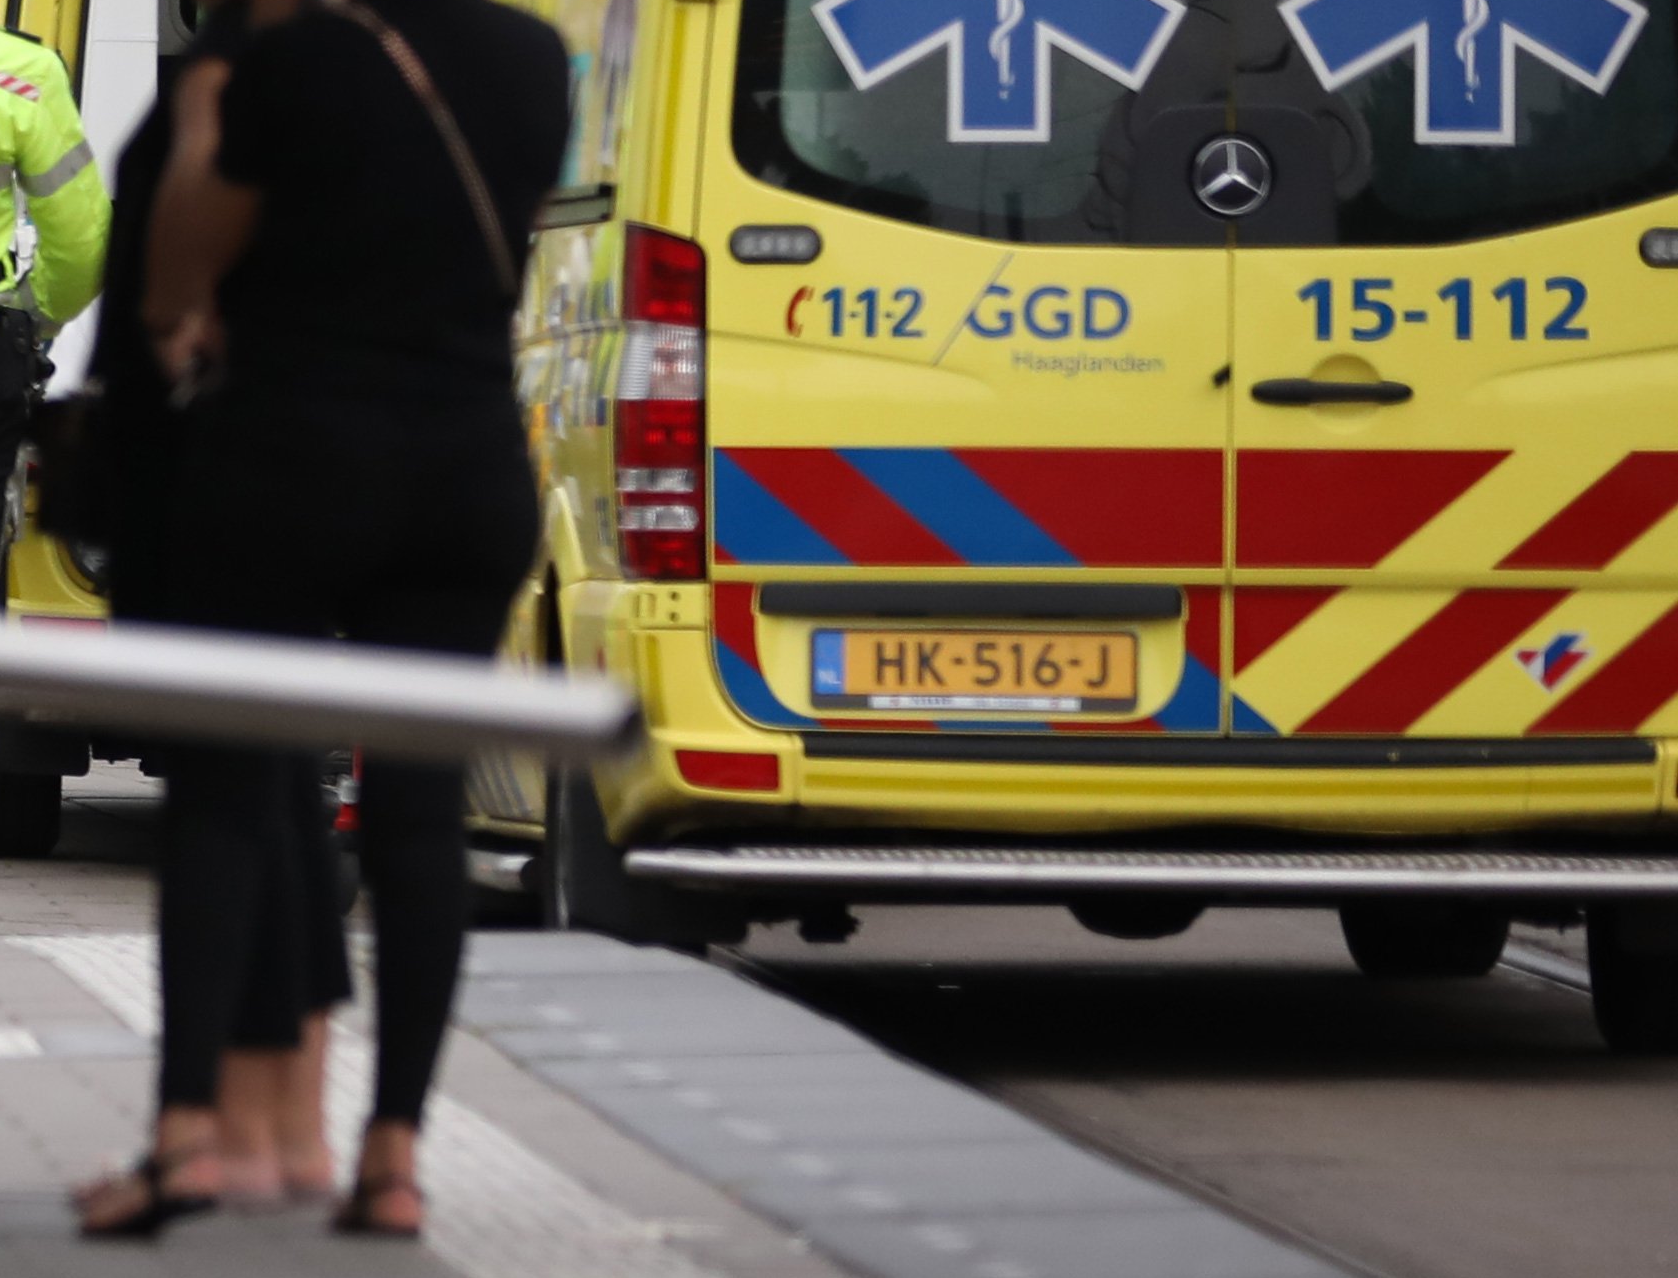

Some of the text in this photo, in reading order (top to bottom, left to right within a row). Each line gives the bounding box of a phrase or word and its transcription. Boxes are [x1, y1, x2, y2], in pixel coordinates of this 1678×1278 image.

[822, 286, 926, 339] 1-1-2
[965, 285, 1131, 340] GGD
[1296, 276, 1590, 342] 15-112
[1013, 351, 1165, 378] Haaglanden
[875, 639, 1111, 688] HK-516-J
